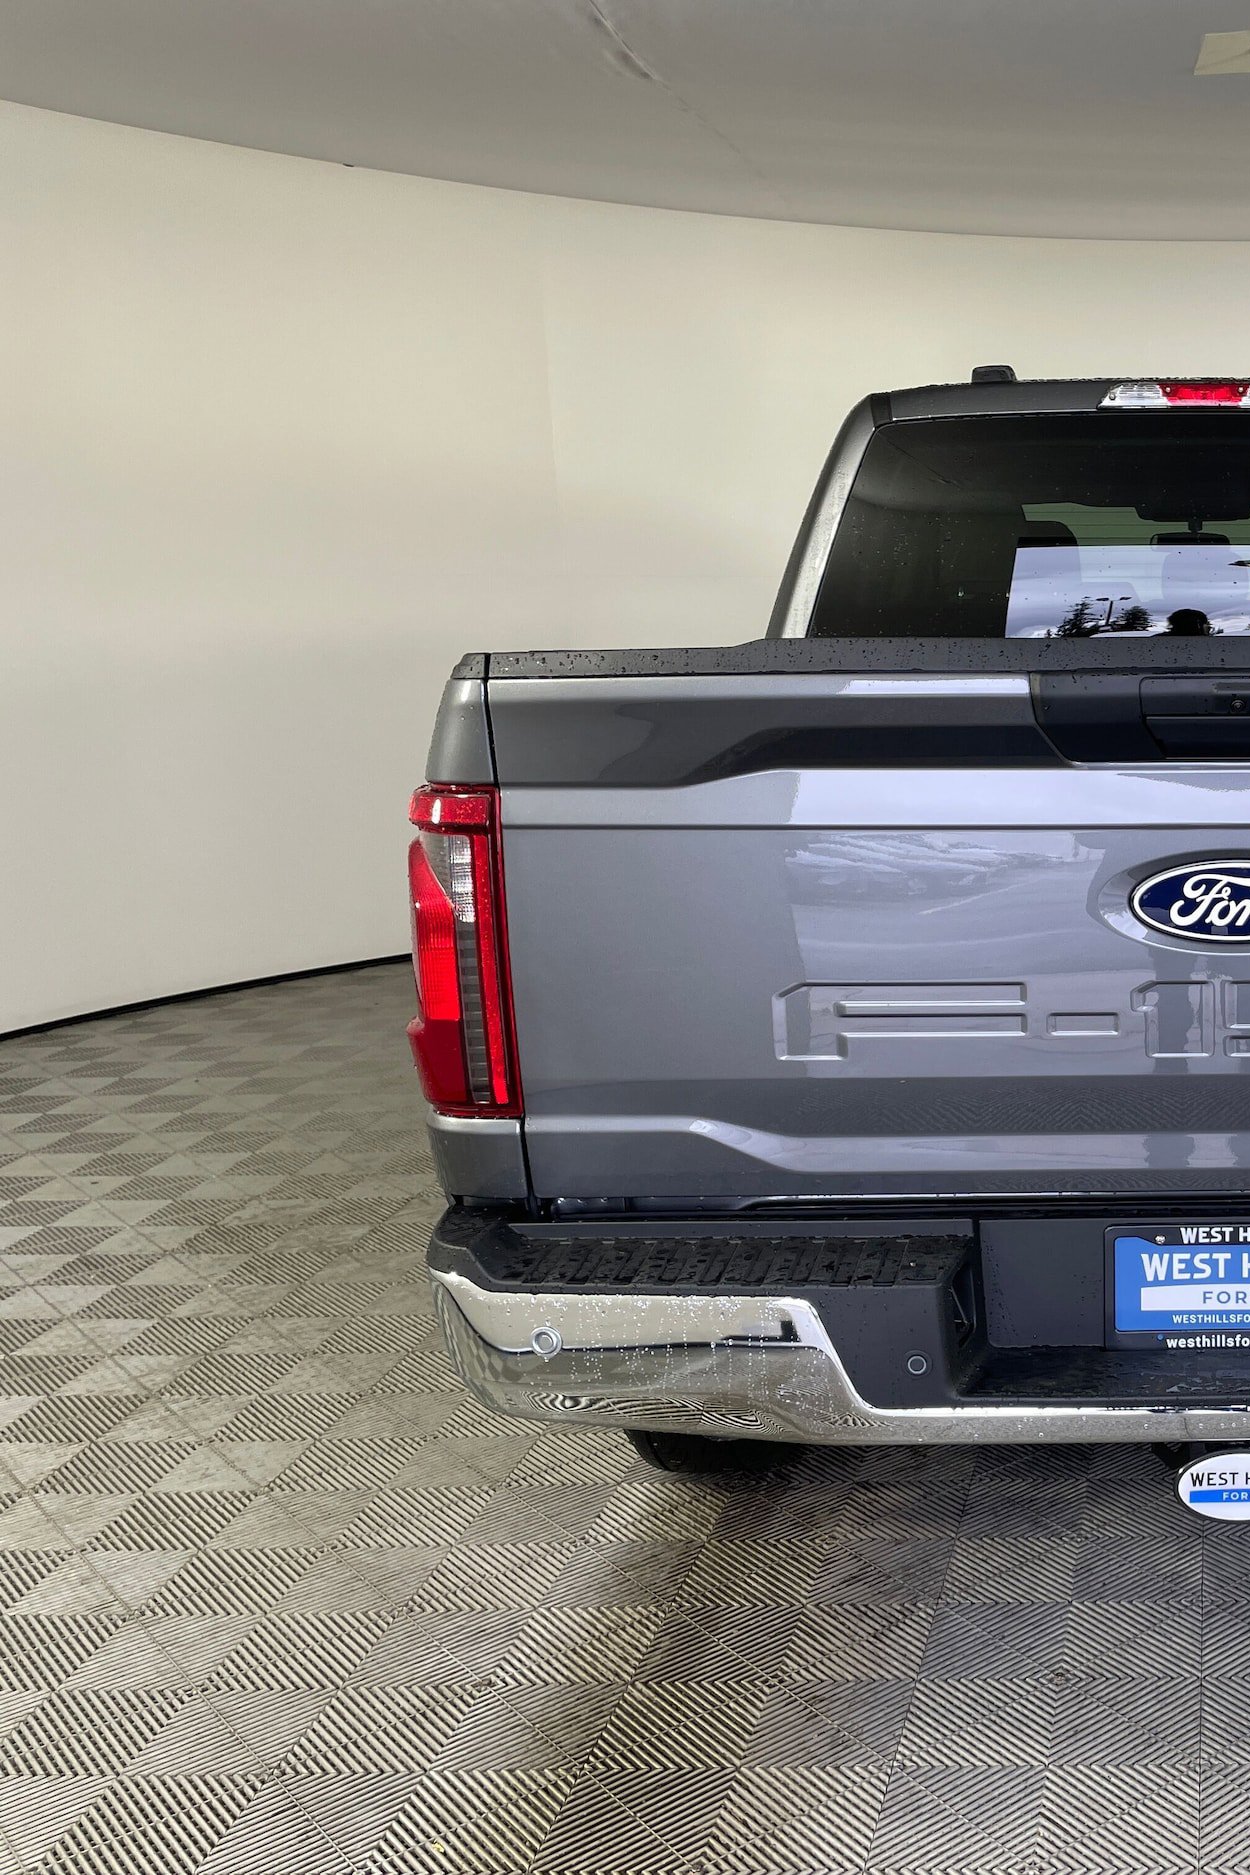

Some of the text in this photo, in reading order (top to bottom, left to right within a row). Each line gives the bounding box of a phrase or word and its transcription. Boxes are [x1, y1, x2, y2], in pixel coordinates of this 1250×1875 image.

[1180, 1227, 1234, 1244] WEST
[1141, 1252, 1231, 1281] WEST
[1190, 1472, 1238, 1487] WEST
